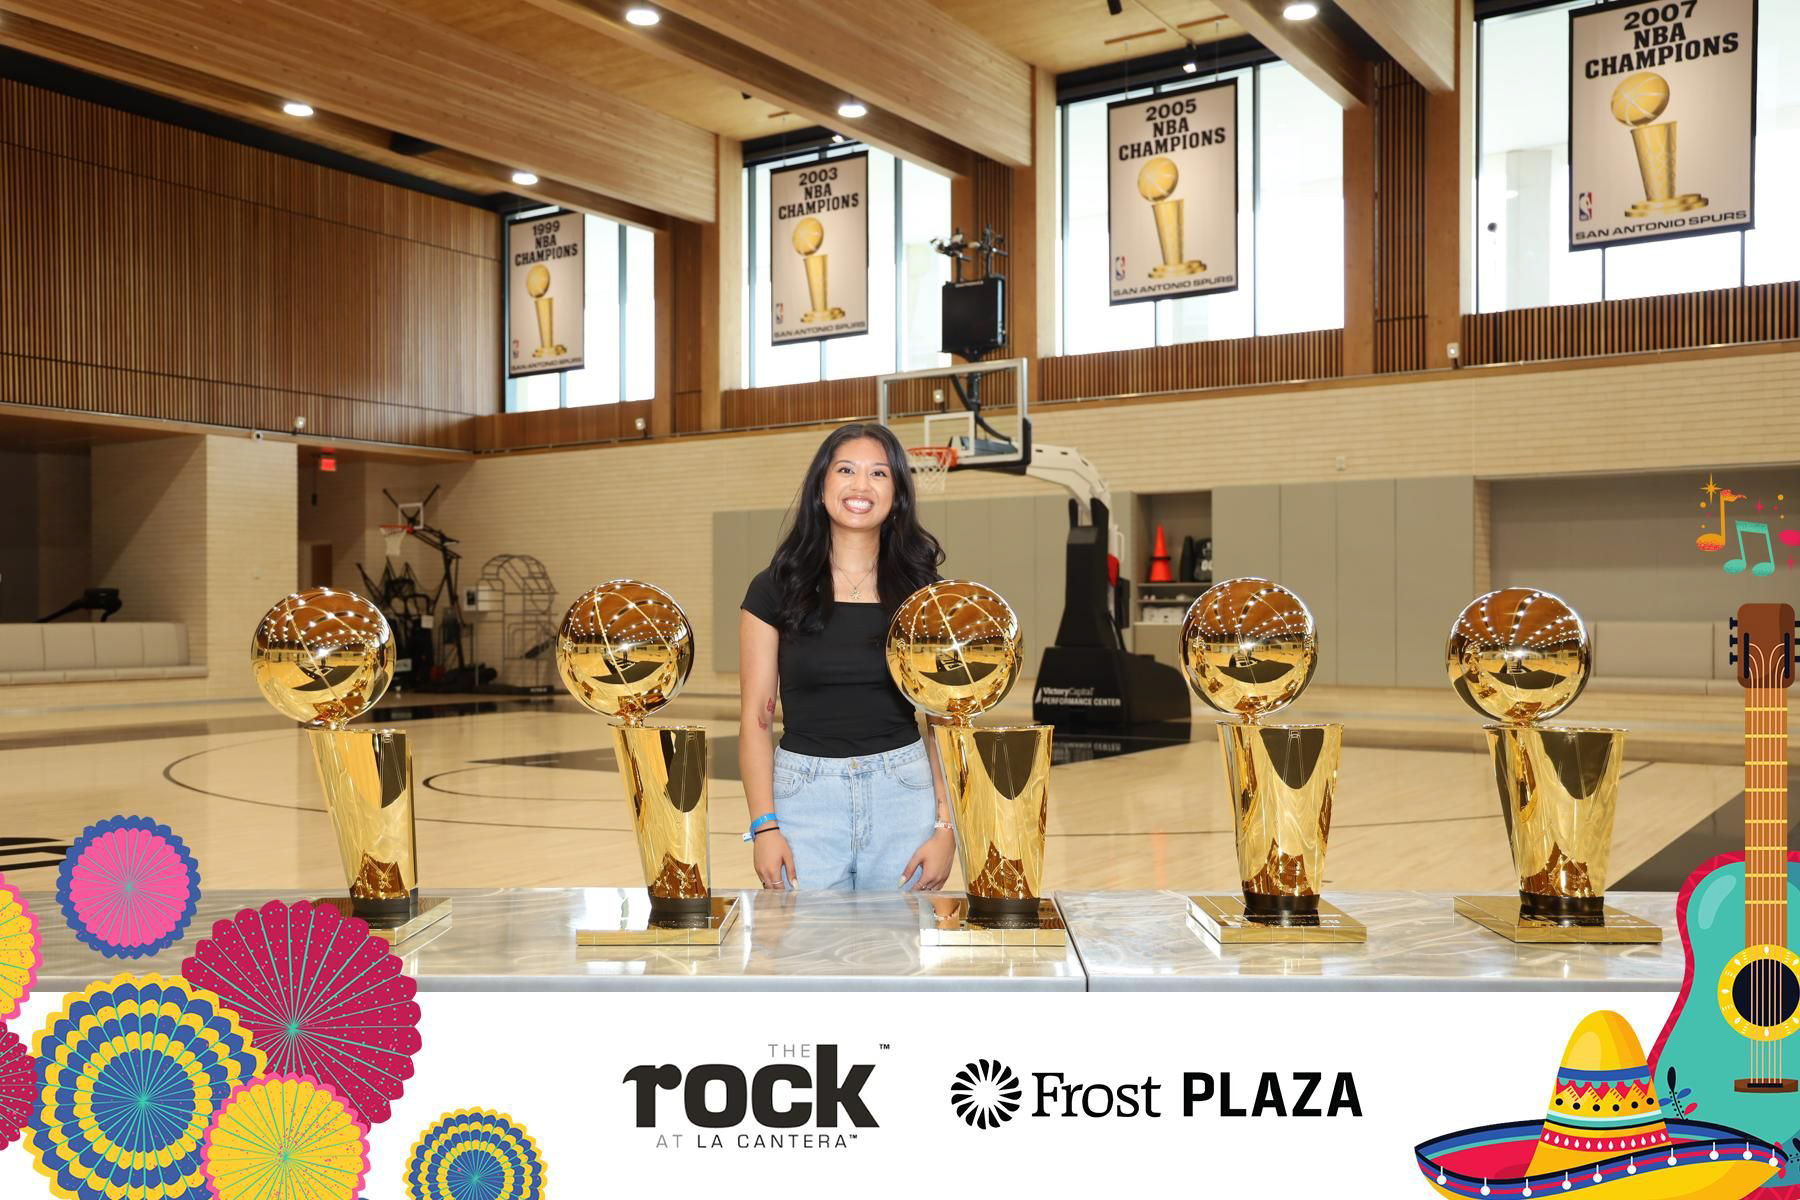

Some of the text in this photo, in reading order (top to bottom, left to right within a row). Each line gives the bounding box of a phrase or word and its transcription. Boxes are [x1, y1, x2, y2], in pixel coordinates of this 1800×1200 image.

[1624, 0, 1698, 31] 2007
[1633, 22, 1686, 50] NBA
[1585, 32, 1739, 80] CHAMPIONS
[1146, 98, 1197, 122] 2005
[1152, 117, 1189, 138] NBA
[1118, 127, 1226, 161] CHAMPIONS
[799, 167, 838, 186] 2003
[804, 183, 832, 200] NBA
[778, 193, 859, 220] CHAMPIONS
[532, 220, 560, 236] 1999
[1575, 210, 1747, 241] SAN ANTONIO SPURS
[535, 234, 557, 249] NBA
[514, 243, 578, 266] CHAMPIONS
[1113, 275, 1234, 297] SAN ANTONIO SPURS
[774, 321, 865, 339] SAN ANTONIO SPURS
[1043, 697, 1121, 707] PERFORMANCE CENTER
